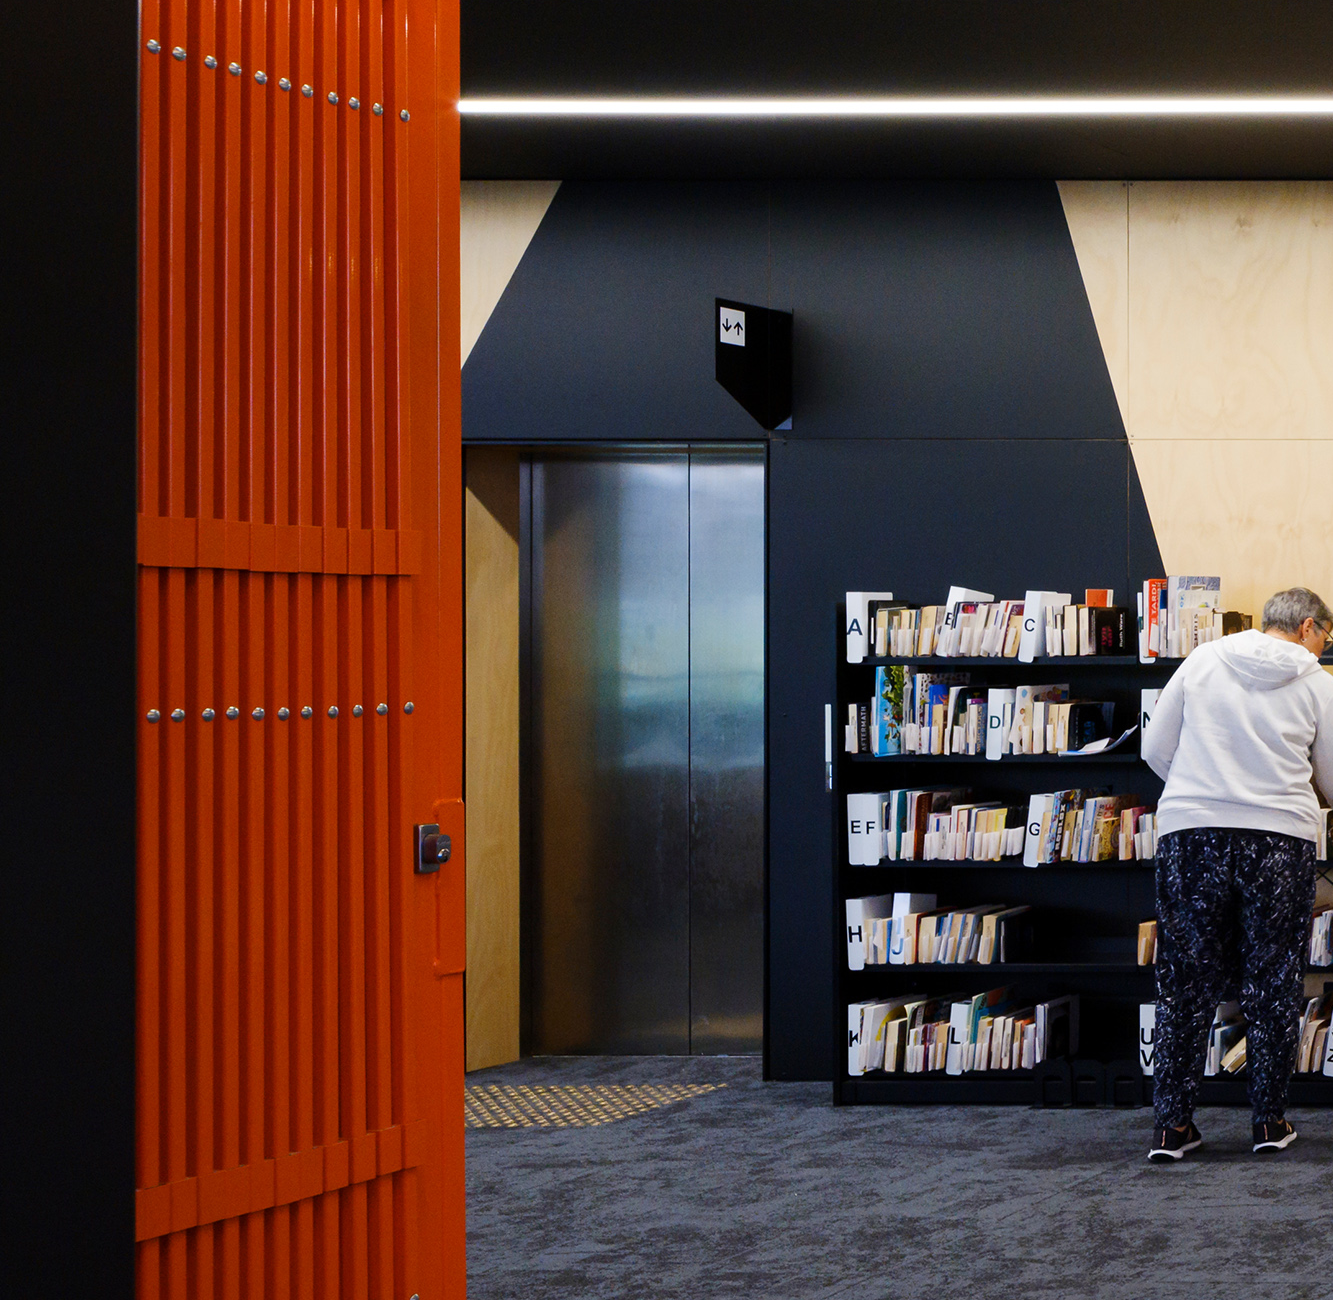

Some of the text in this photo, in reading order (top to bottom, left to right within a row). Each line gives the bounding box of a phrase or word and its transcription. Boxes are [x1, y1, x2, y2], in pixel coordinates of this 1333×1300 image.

[847, 618, 863, 635] A
[1024, 618, 1036, 632] C
[989, 715, 1001, 729] D
[851, 820, 875, 835] E F
[1029, 822, 1040, 836] G
[1055, 804, 1066, 850] ROBLOX
[848, 925, 862, 943] H
[951, 1027, 961, 1044] L
